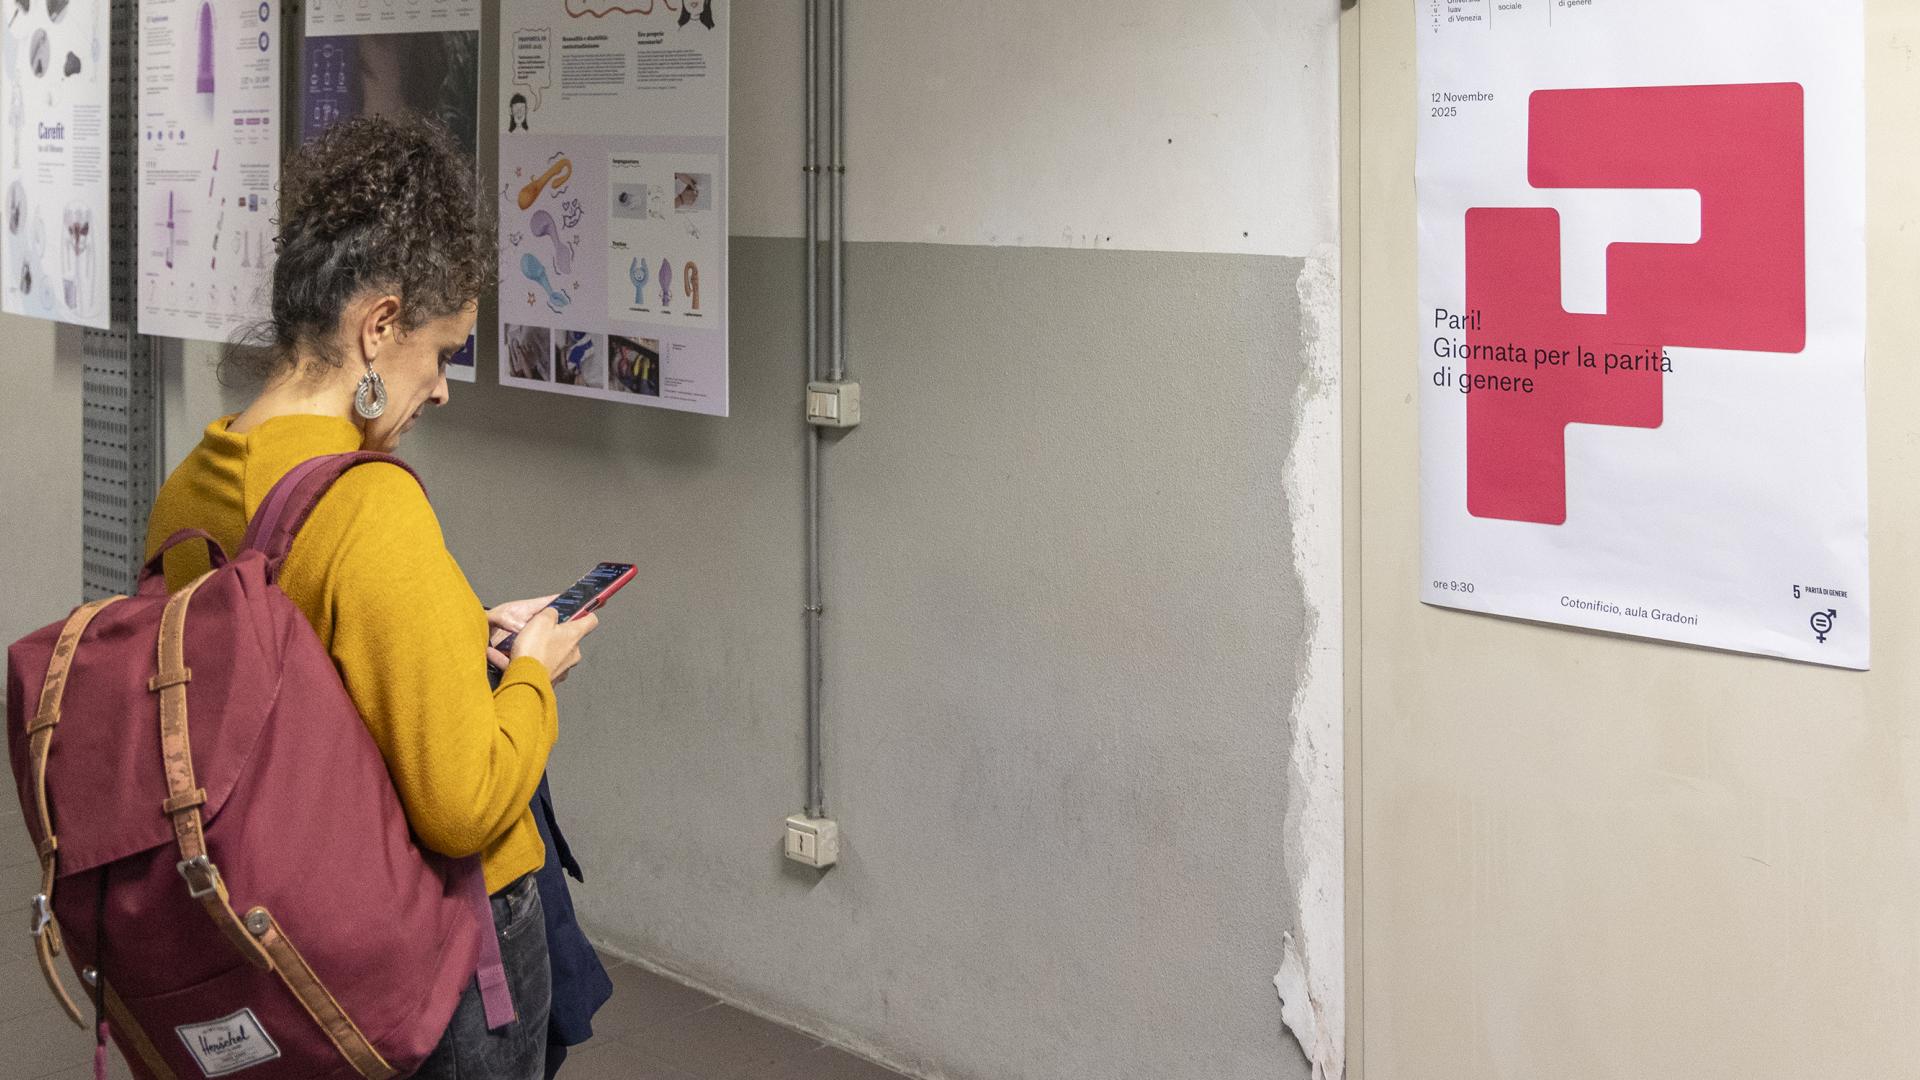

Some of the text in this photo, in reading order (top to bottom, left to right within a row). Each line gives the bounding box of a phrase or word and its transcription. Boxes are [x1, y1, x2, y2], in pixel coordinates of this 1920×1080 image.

[1498, 3, 1522, 11] sociale
[1567, 0, 1592, 8] genere
[1447, 15, 1455, 23] di
[1431, 92, 1494, 103] 12 Novembre
[1431, 107, 1457, 117] 2025
[38, 121, 65, 140] Carefit
[1434, 308, 1482, 331] Pari!
[1433, 337, 1674, 375] Giornata per la parità
[1433, 366, 1534, 394] di genere
[1433, 581, 1475, 593] ore 9:30
[1793, 584, 1801, 599] 5
[1829, 589, 1848, 598] GENERE
[1560, 596, 1698, 626] Cotonificio, aula Gradoni
[198, 1024, 250, 1056] Herschel
